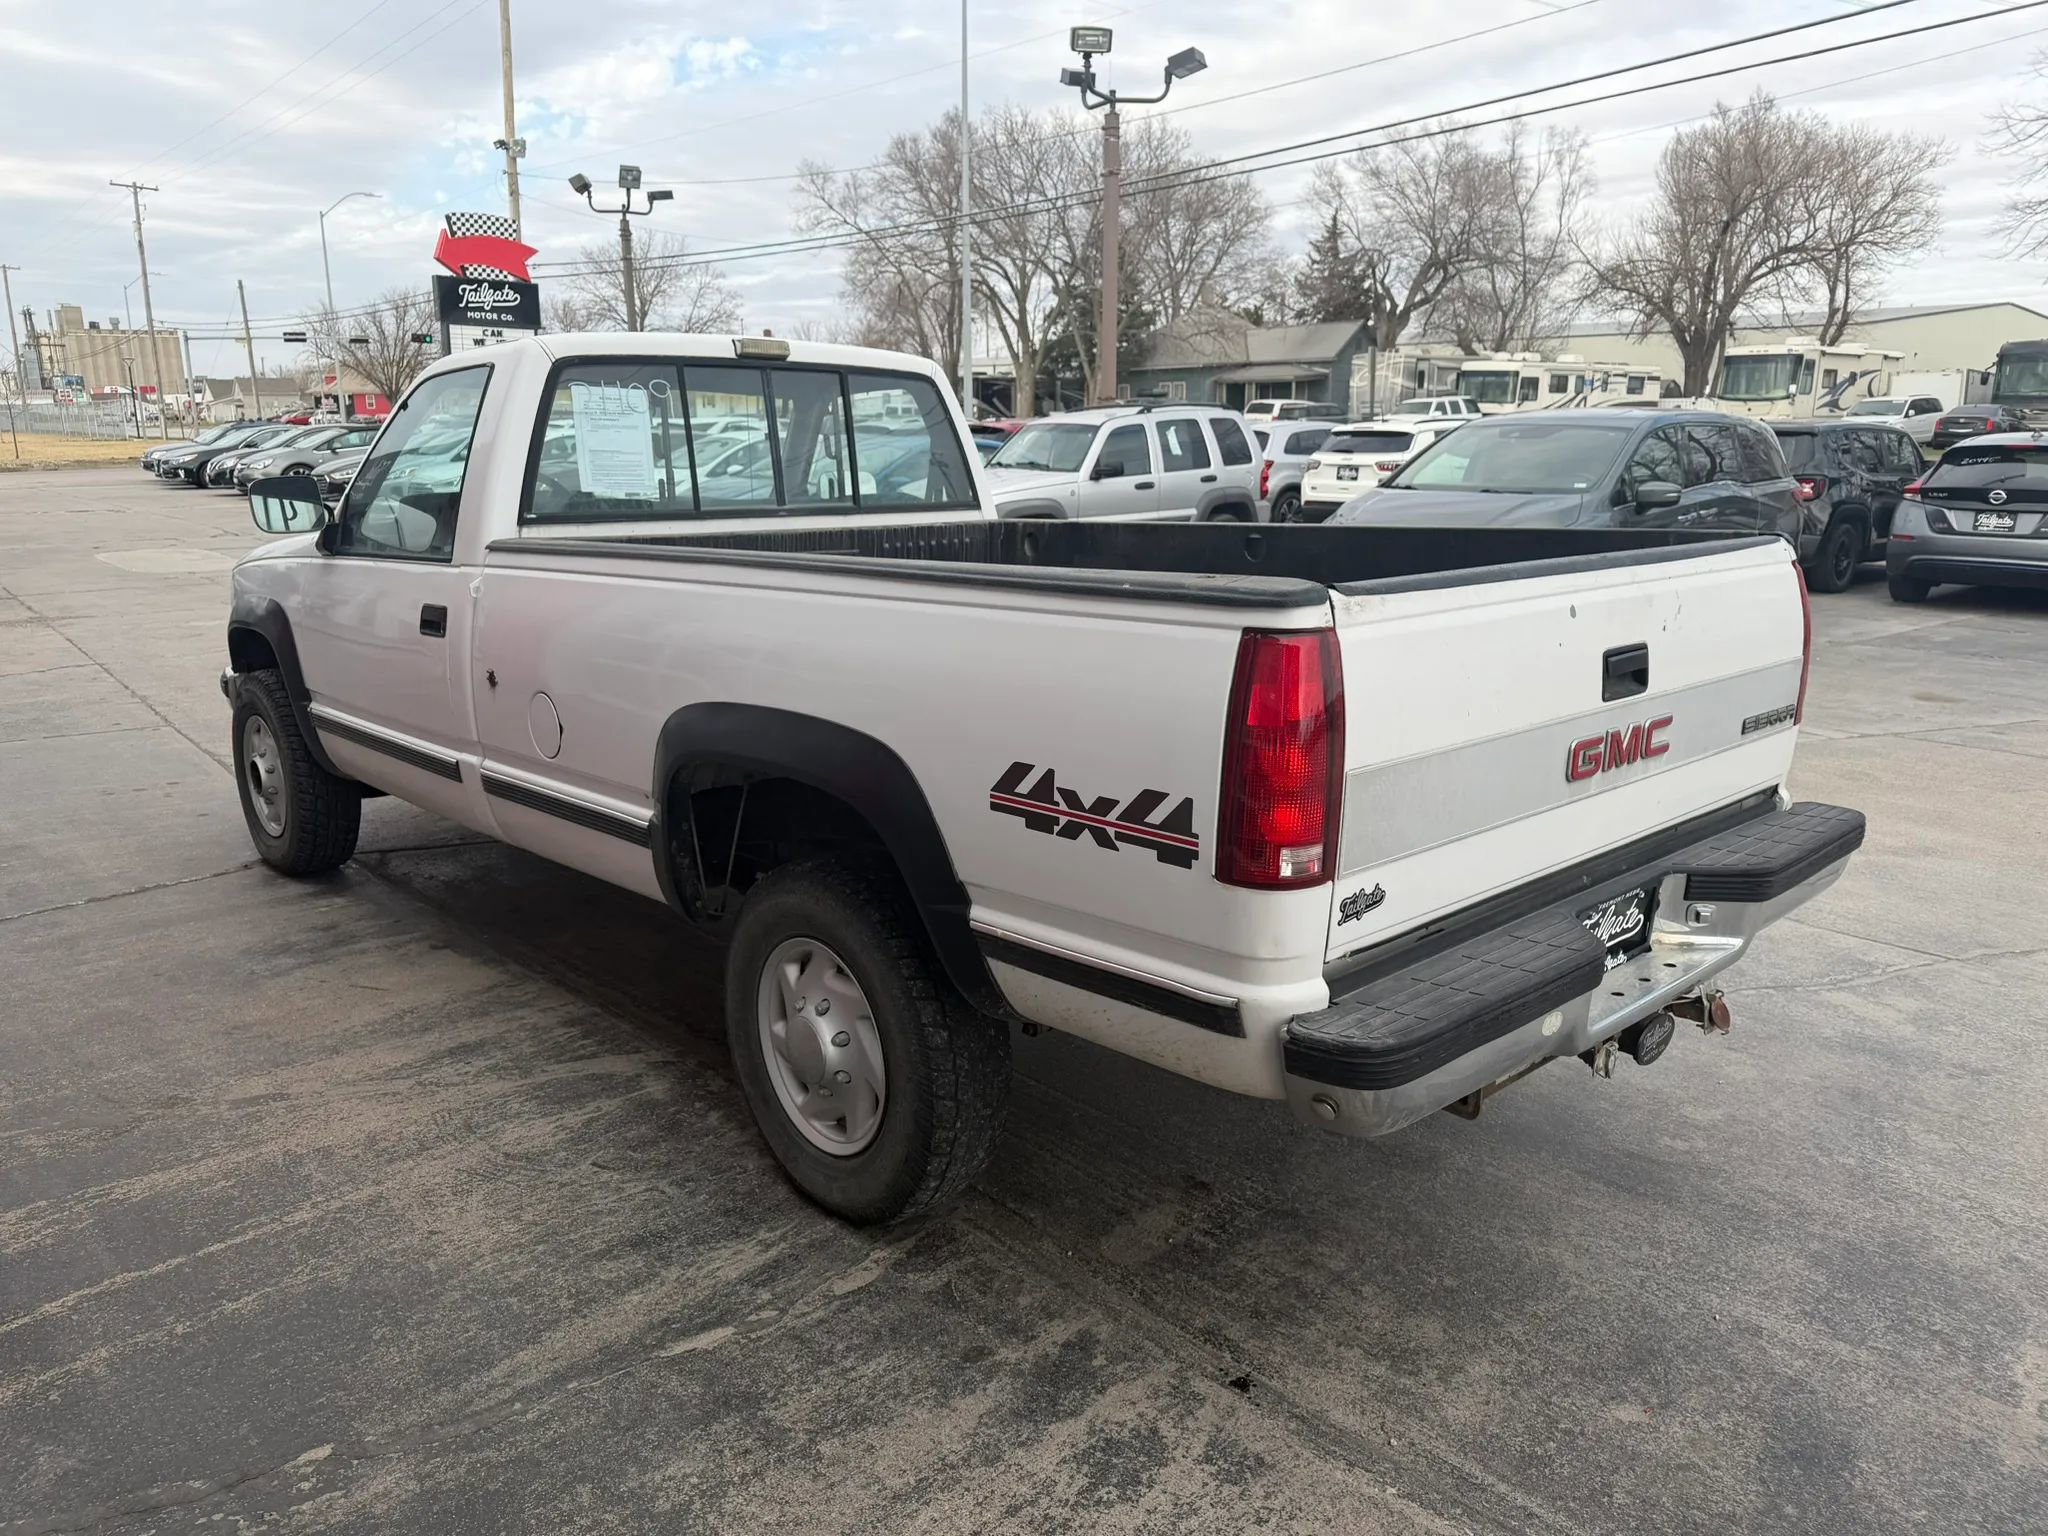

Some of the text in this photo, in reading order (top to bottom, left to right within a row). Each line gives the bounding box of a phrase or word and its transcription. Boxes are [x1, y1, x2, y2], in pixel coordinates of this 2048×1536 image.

[458, 282, 521, 310] Tailgate
[467, 311, 499, 320] MOTOR
[1975, 513, 2014, 528] Tailgate
[1741, 703, 1796, 735] SIERRA
[1566, 712, 1674, 783] GMC
[1337, 882, 1386, 926] Tailgate
